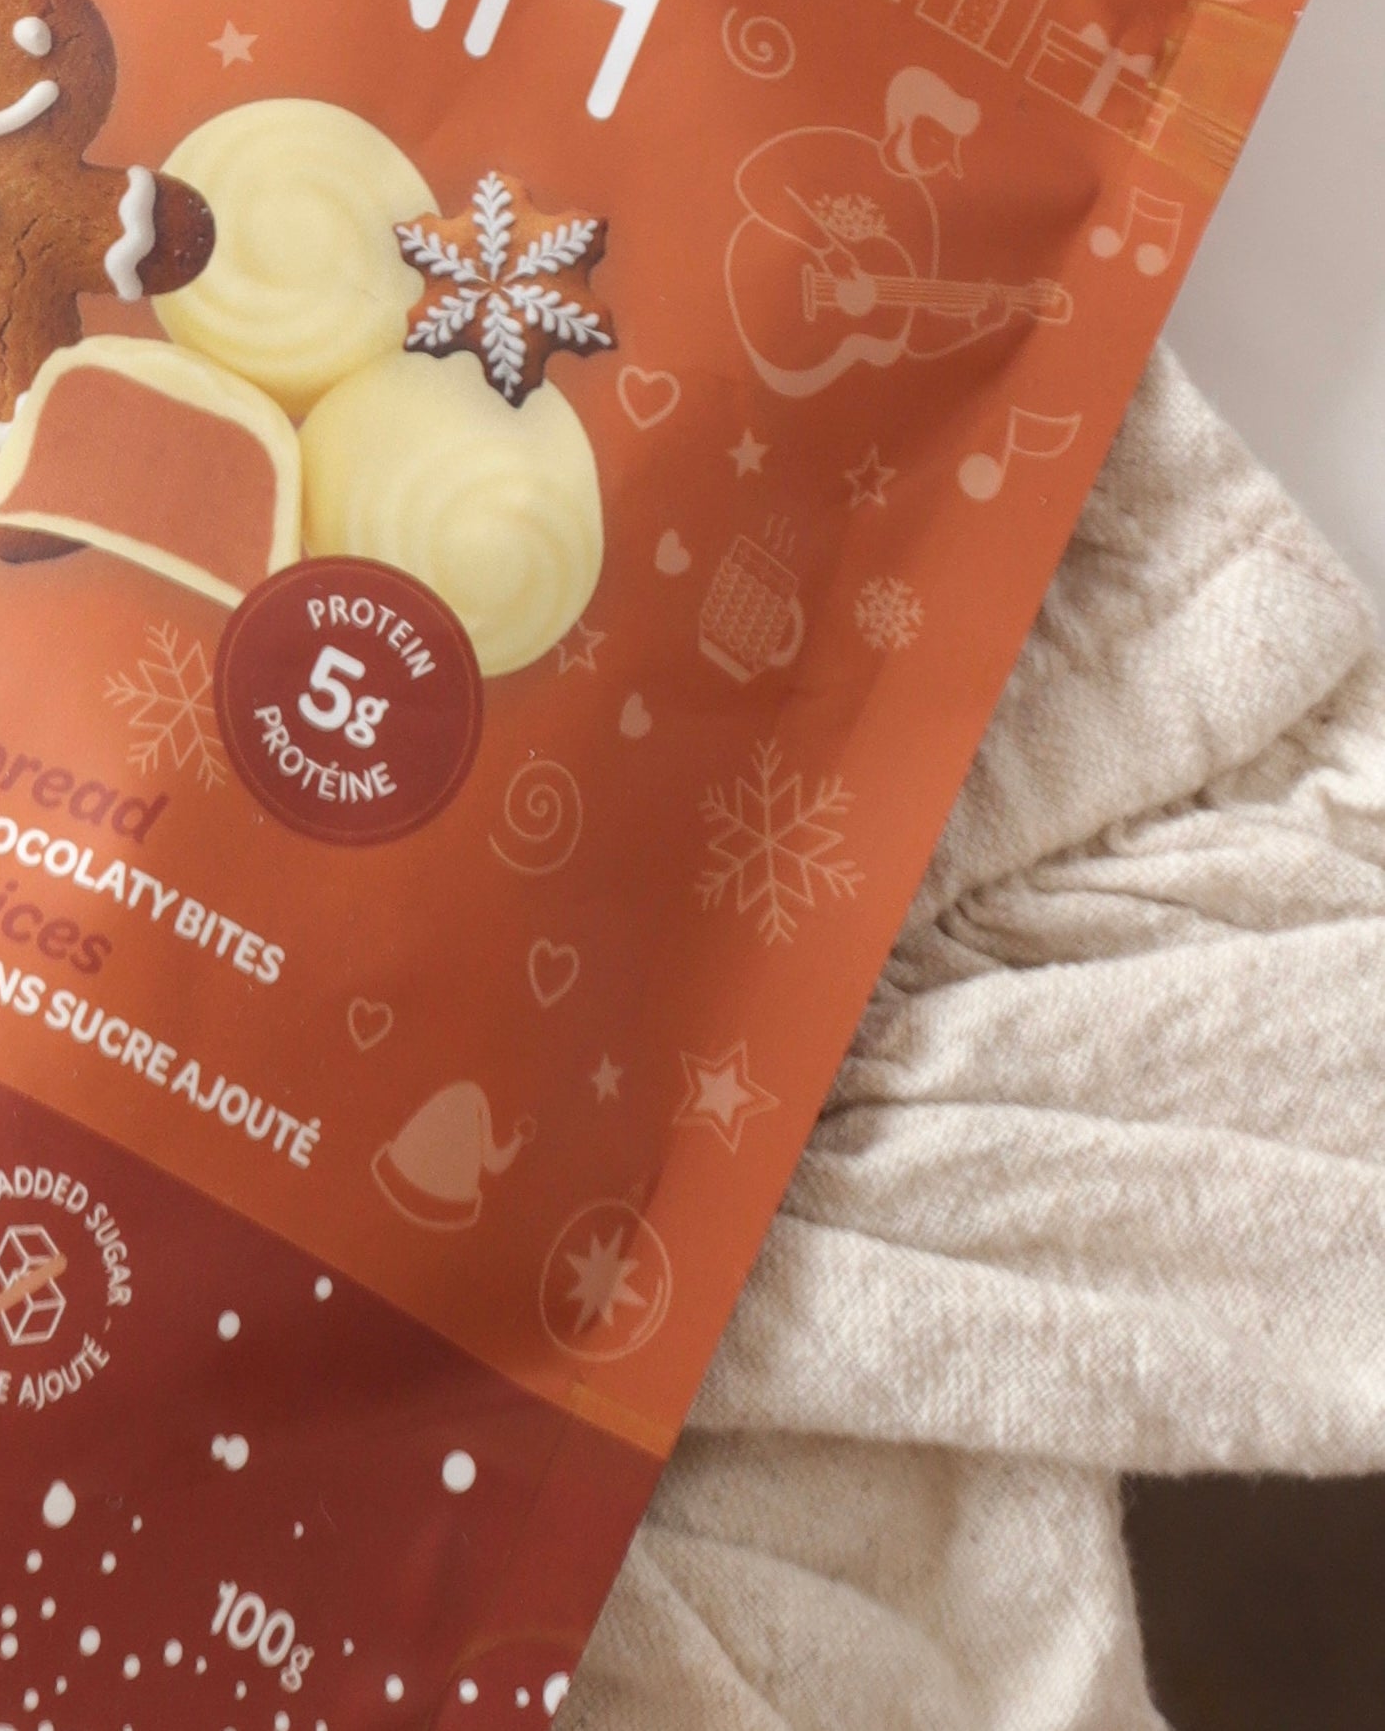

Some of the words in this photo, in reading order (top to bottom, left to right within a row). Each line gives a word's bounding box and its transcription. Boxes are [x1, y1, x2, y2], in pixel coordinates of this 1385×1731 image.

[307, 594, 436, 679] PROTEIN
[298, 645, 390, 748] 5g
[253, 705, 397, 803] PROTÉINE
[174, 896, 286, 984] BITES
[44, 989, 177, 1085] SUCRE
[171, 1061, 322, 1168] AJOUTÉ
[84, 1202, 132, 1307] SUGAR
[17, 1333, 110, 1412] AJOUTÉ
[210, 1579, 315, 1693] 100g
